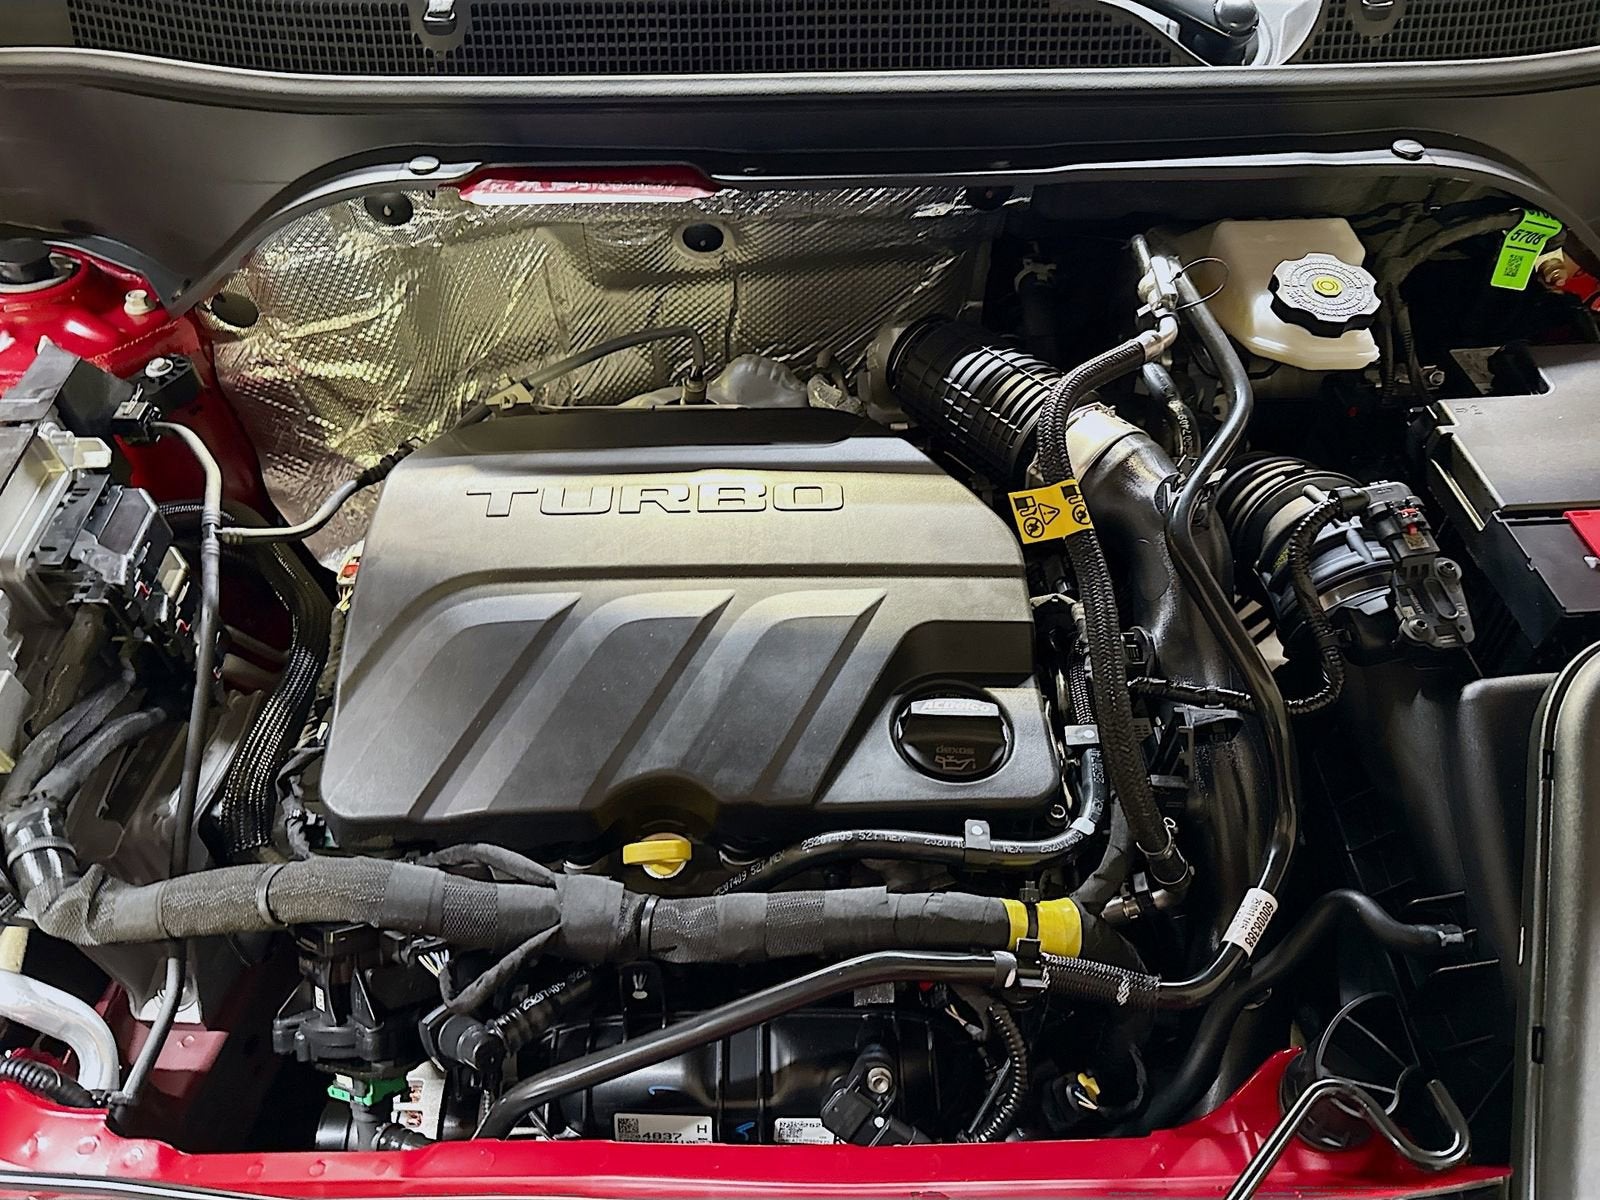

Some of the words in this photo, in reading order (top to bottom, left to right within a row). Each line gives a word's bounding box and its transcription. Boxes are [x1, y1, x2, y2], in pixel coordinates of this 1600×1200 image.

[1510, 229, 1546, 245] 5708
[466, 484, 845, 518] TURBO
[1244, 901, 1274, 948] 60008388
[696, 1124, 707, 1134] H
